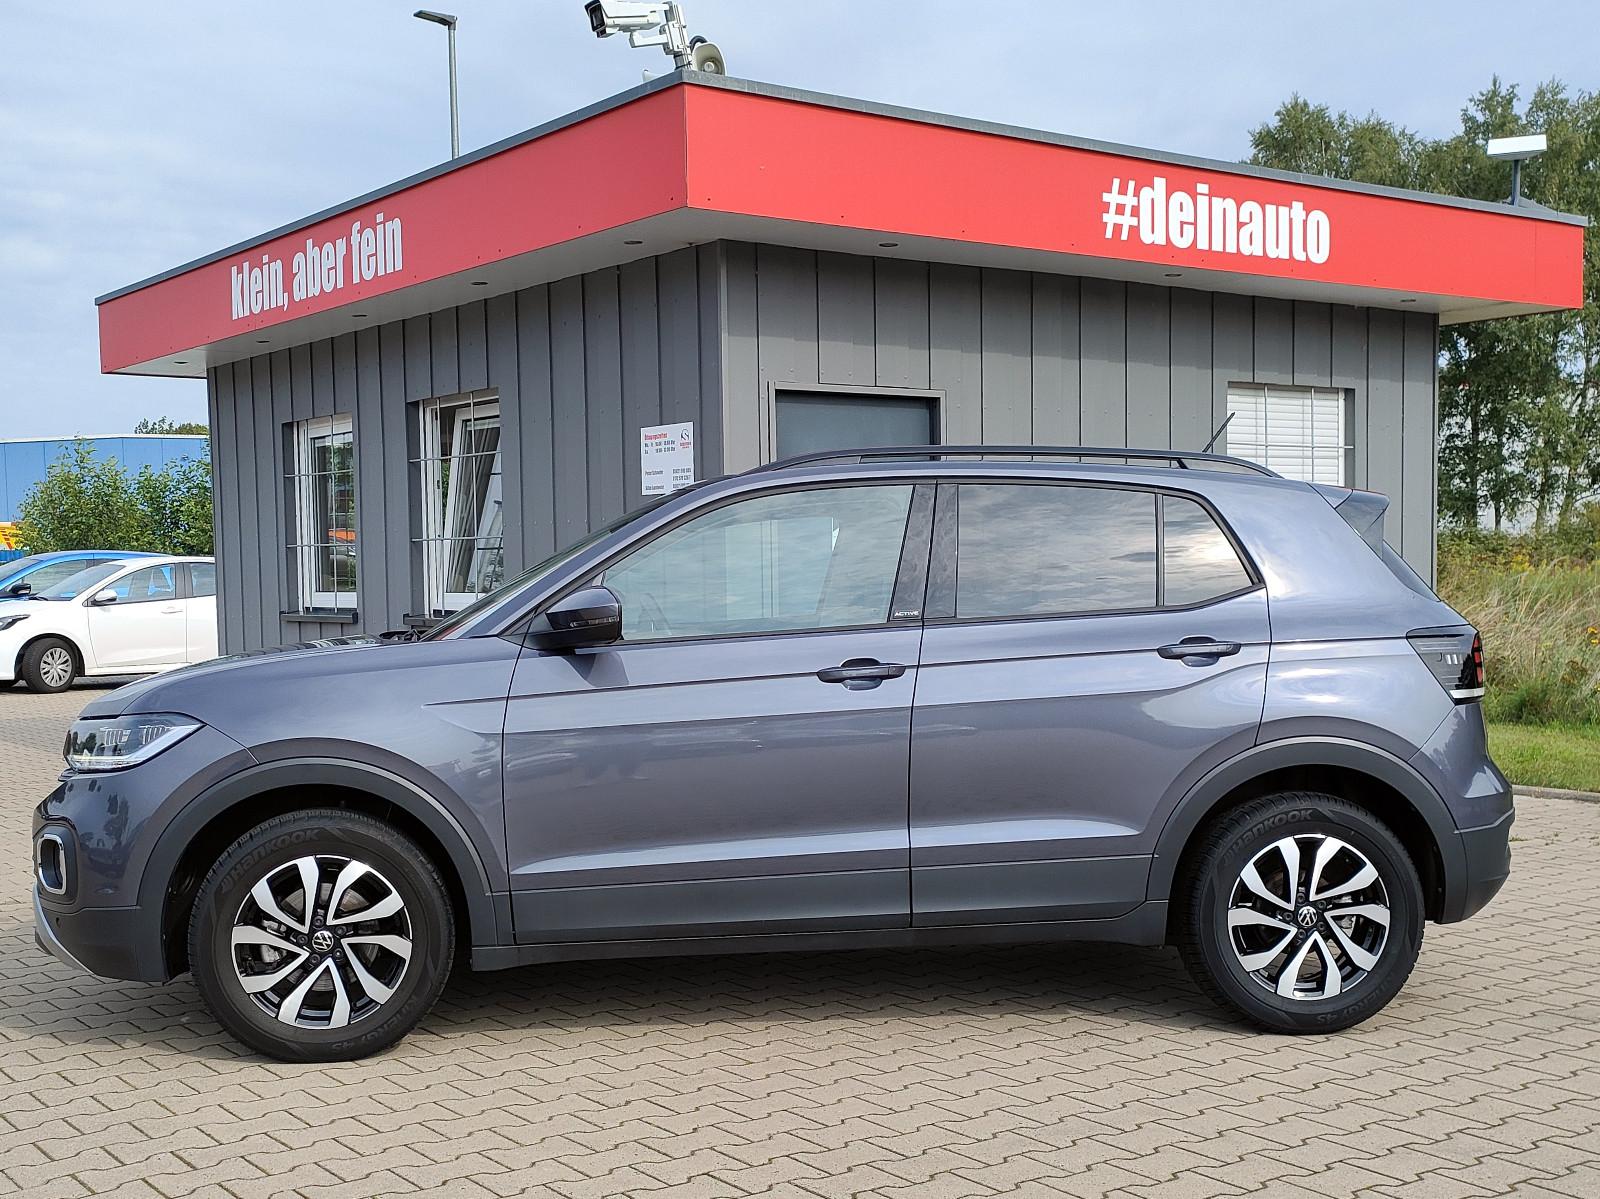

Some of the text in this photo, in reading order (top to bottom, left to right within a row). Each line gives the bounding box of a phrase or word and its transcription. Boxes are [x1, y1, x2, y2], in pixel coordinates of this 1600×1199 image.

[231, 213, 403, 320] klein, aber fein
[1102, 176, 1330, 264] #deinauto
